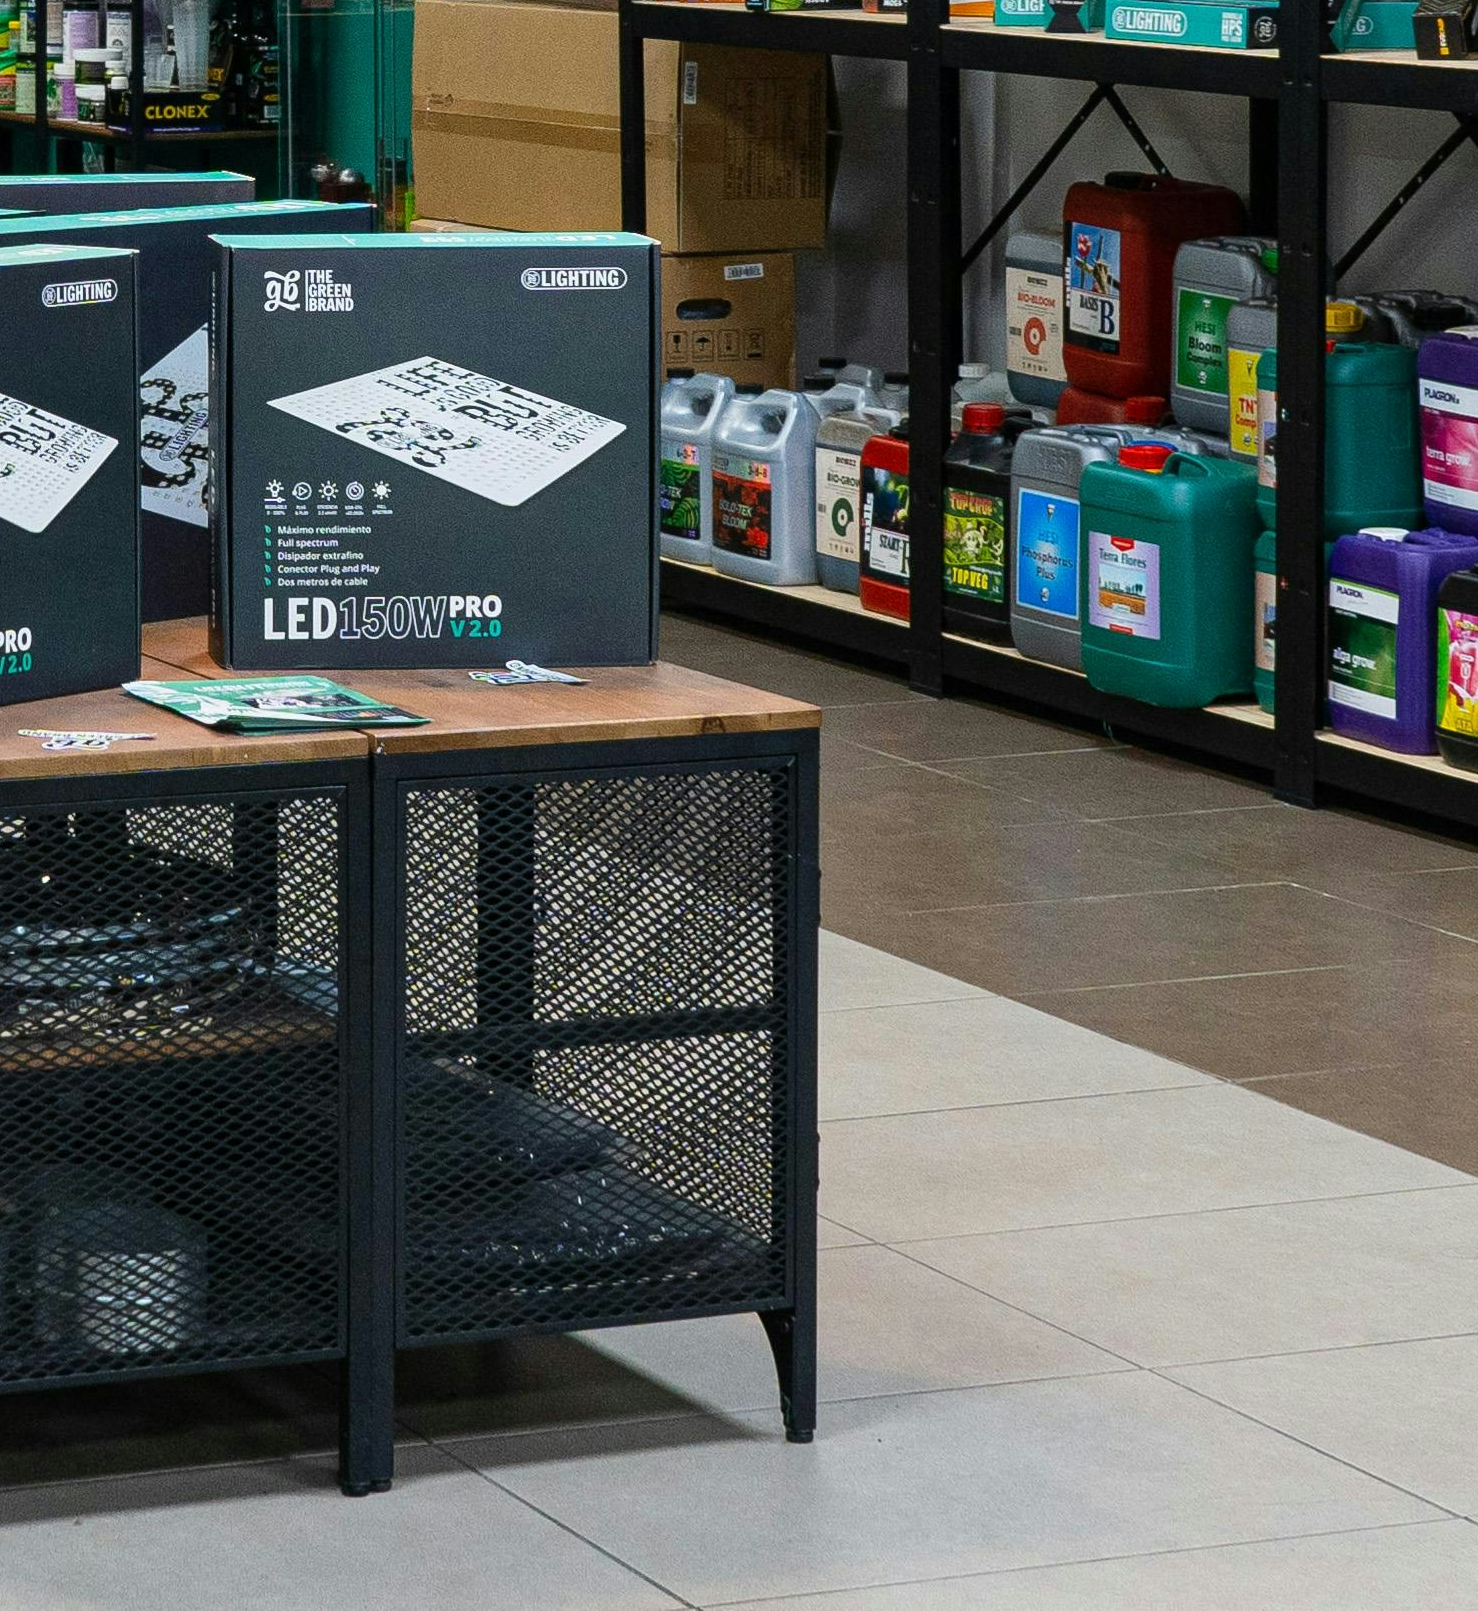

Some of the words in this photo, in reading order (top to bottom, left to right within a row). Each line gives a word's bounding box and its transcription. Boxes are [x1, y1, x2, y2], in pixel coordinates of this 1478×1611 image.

[1125, 10, 1184, 33] LIGHTING
[1221, 19, 1242, 35] HPS
[144, 102, 210, 120] CLONEX
[308, 269, 334, 284] THE
[541, 269, 619, 288] LIGHTING
[56, 281, 113, 303] LIGHTING
[308, 283, 352, 298] GREEN
[308, 297, 354, 312] BRAND
[1016, 291, 1056, 308] BIO-BLOOM
[1079, 294, 1100, 311] BASIS
[1100, 300, 1115, 336] B
[1195, 321, 1217, 335] HESI
[1188, 338, 1222, 354] Bloom
[277, 524, 315, 535] Máximo
[315, 525, 372, 535] rendimiento
[277, 538, 294, 548] Full
[295, 539, 339, 550] spectrum
[277, 551, 321, 563] Disipador
[322, 551, 364, 561] extrafino
[1021, 547, 1074, 568] Phosphorus
[1098, 547, 1120, 564] Terra
[1120, 552, 1147, 569] Flores
[277, 564, 318, 574] Conector
[320, 564, 340, 576] Plug
[341, 564, 359, 574] and
[360, 564, 380, 576] Play
[951, 565, 969, 588] TOP
[969, 568, 988, 590] VEG
[1036, 564, 1056, 581] Plus
[277, 577, 295, 587] Dos
[296, 578, 329, 587] metros
[330, 577, 343, 587] de
[344, 577, 369, 587] cable
[449, 594, 503, 618] PRO
